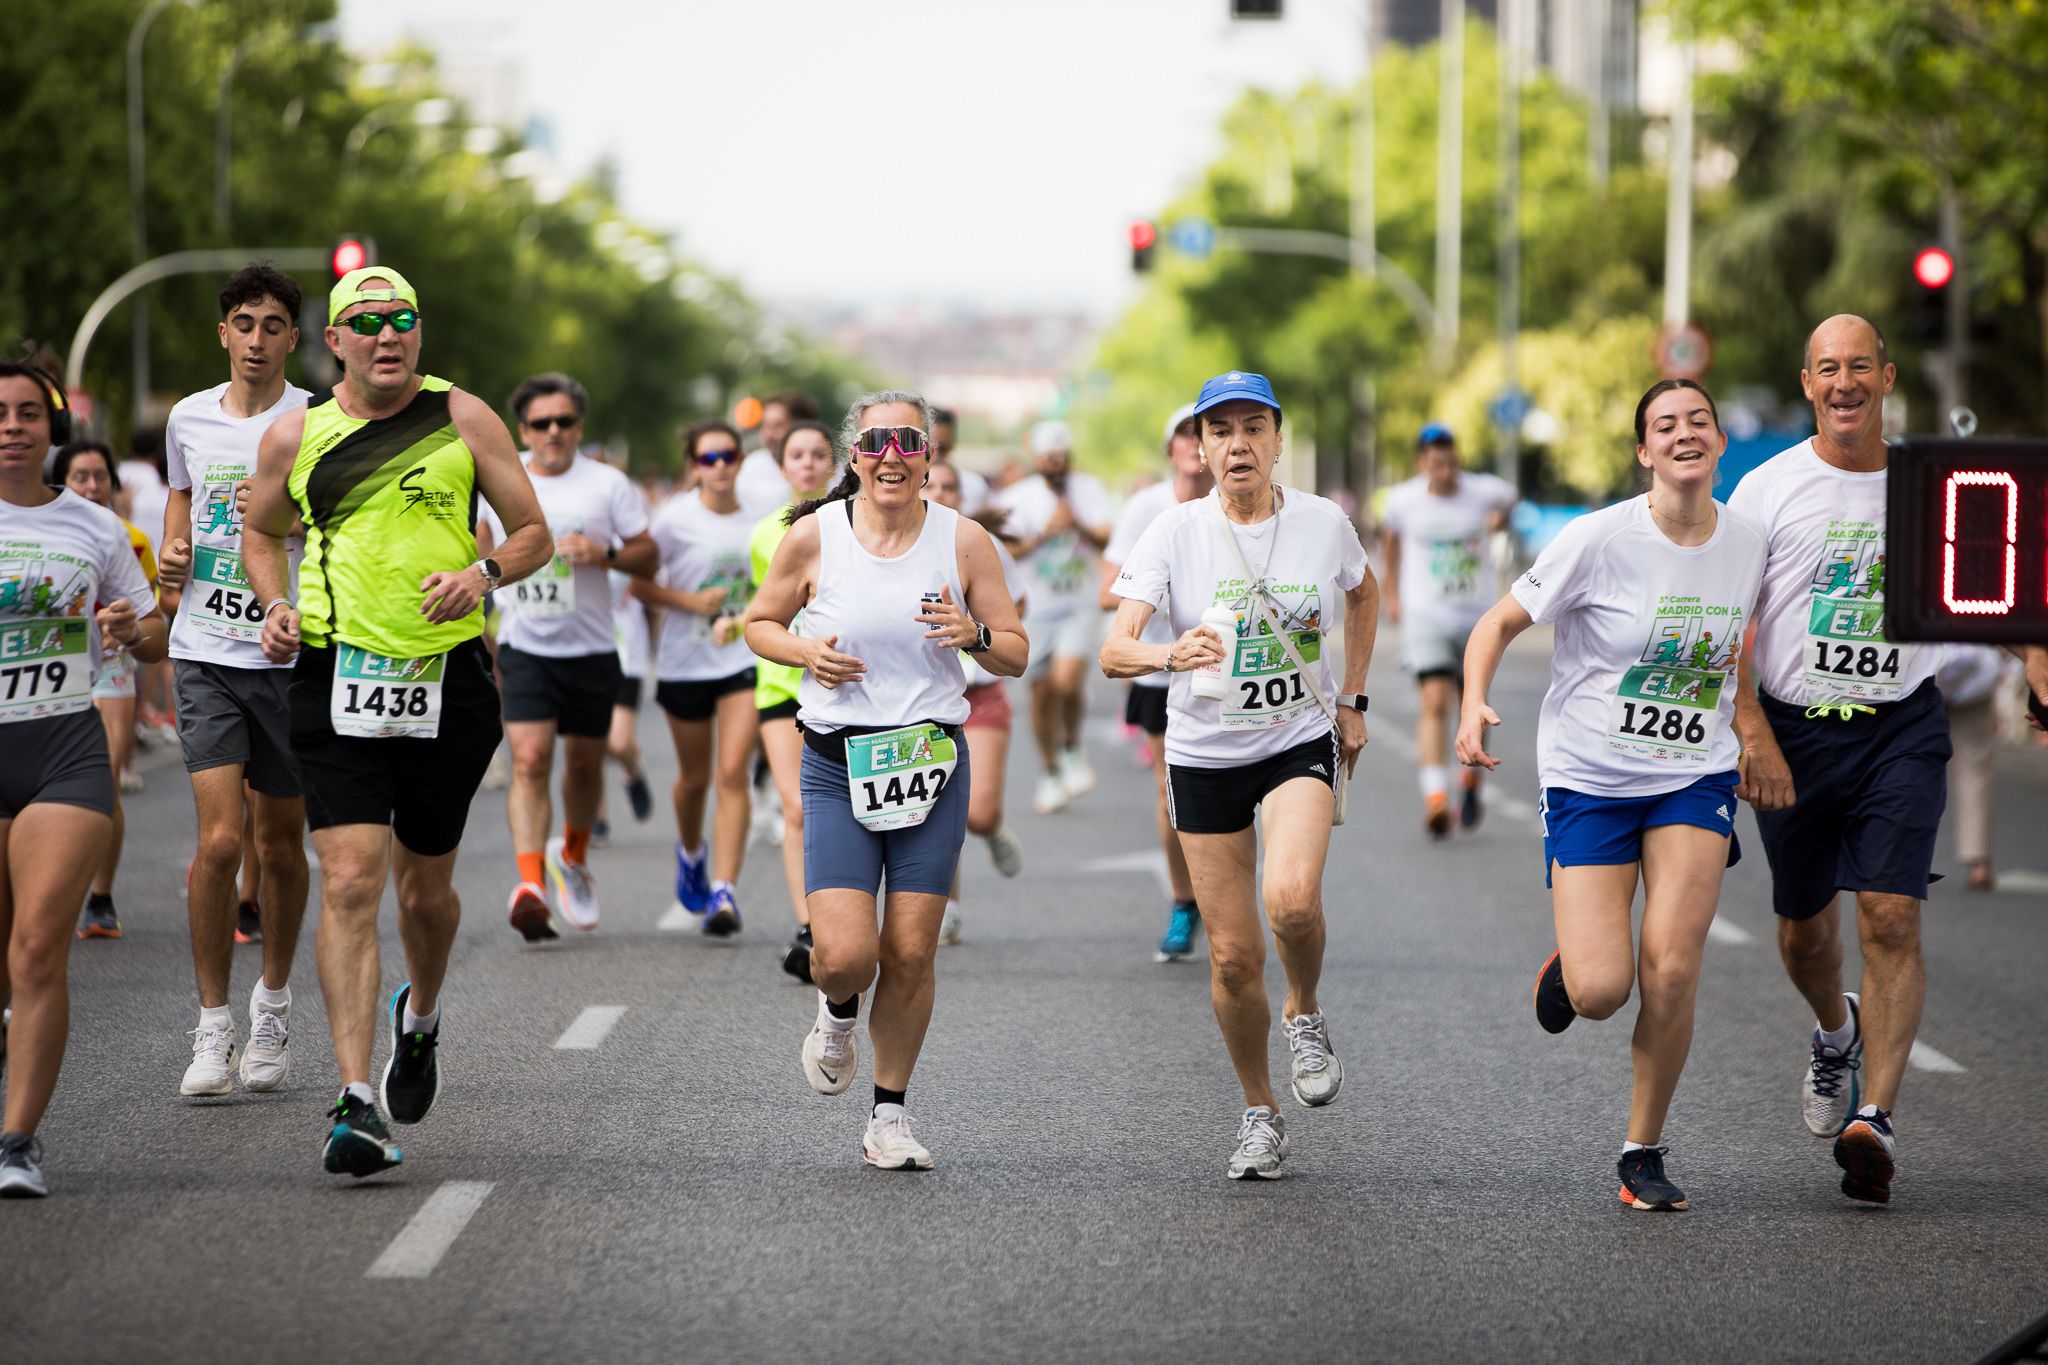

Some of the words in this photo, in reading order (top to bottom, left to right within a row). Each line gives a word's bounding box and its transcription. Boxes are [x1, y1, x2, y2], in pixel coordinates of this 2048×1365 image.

[1827, 529, 1878, 539] MADRID
[1943, 471, 2048, 614] 0
[205, 588, 267, 622] 456
[1271, 584, 1299, 593] CON
[1303, 584, 1318, 593] LA
[1656, 606, 1703, 615] MADRID
[1705, 606, 1728, 616] CON
[1731, 606, 1742, 616] LA
[0, 626, 64, 659] ELA
[1241, 640, 1269, 649] MADRID
[1815, 641, 1900, 679] 1284
[1, 660, 67, 700] 779
[1241, 672, 1306, 710] 201
[1640, 672, 1702, 703] ELA
[344, 684, 428, 718] 1438
[871, 735, 899, 745] MADRID
[899, 732, 914, 740] CON
[1619, 702, 1705, 744] 1286
[871, 736, 934, 772] ELA
[863, 768, 947, 812] 1442
